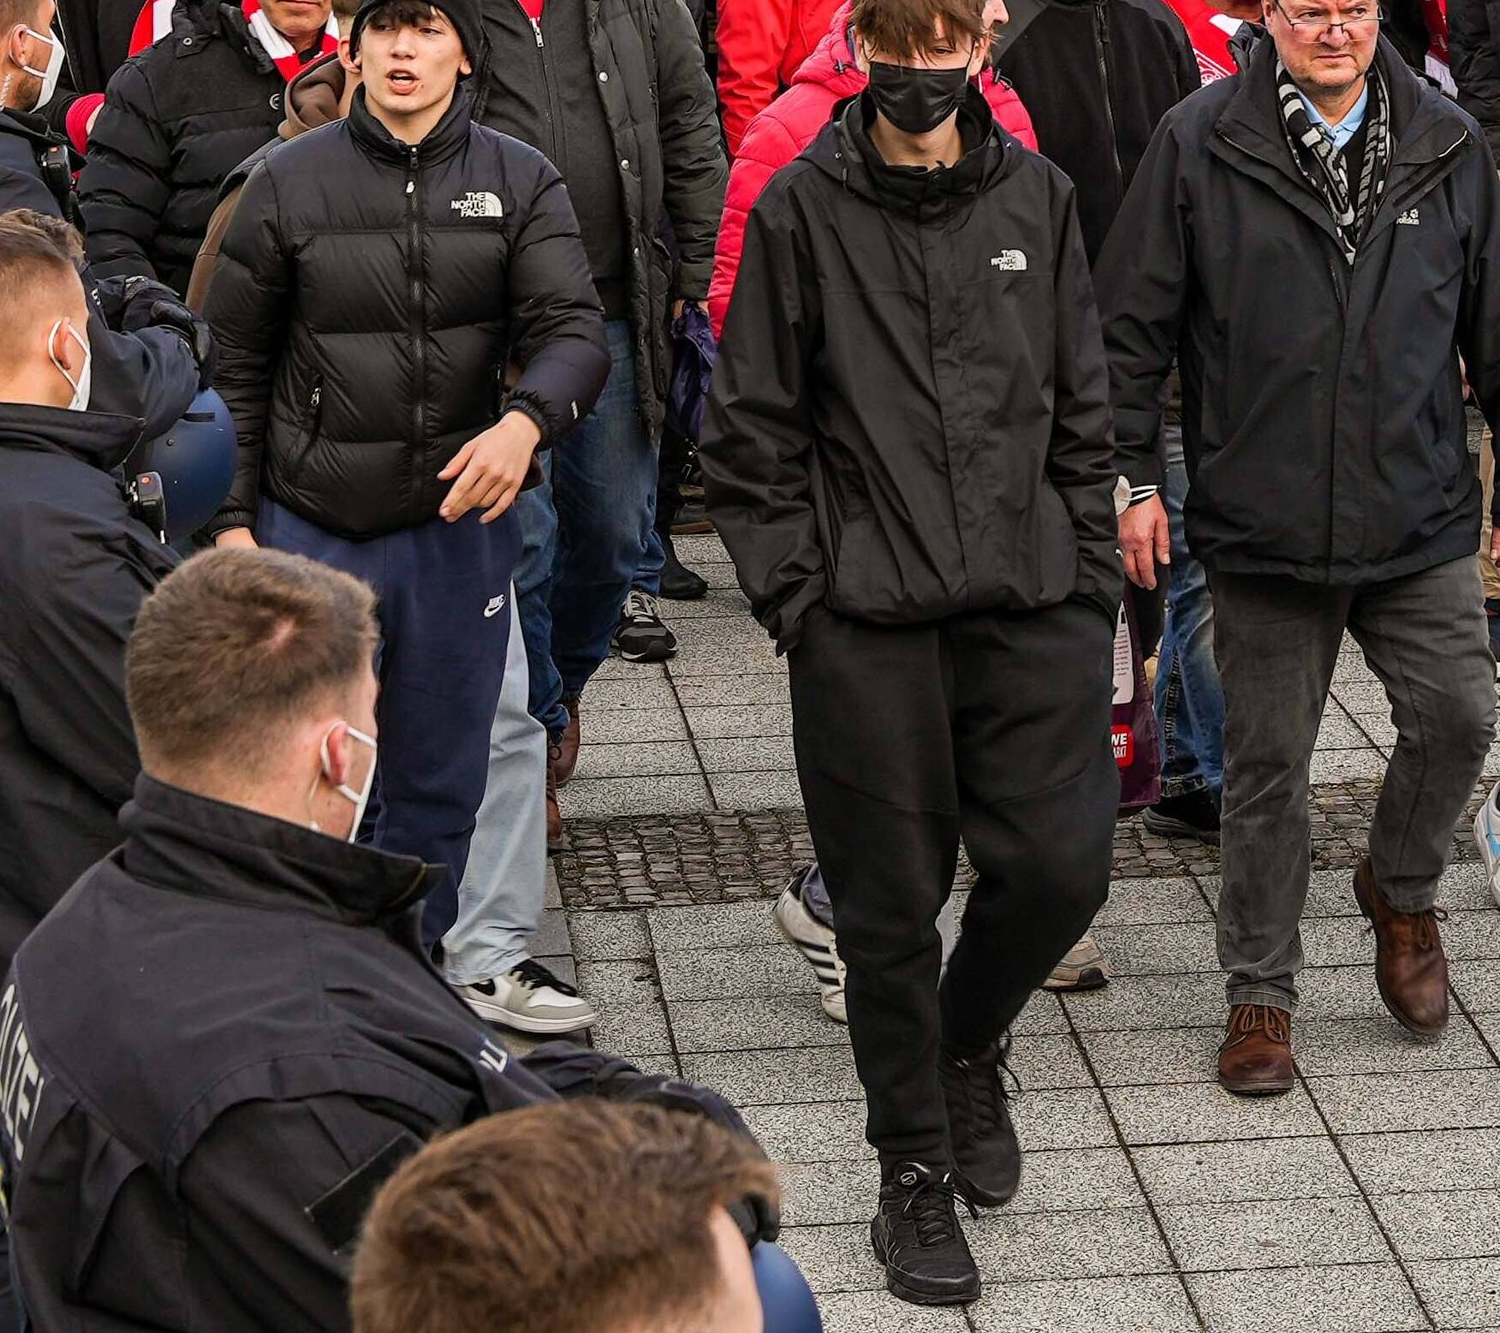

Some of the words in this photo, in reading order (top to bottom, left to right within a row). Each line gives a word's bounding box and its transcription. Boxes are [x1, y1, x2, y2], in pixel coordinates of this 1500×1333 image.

[466, 192, 485, 200] THE
[451, 200, 485, 209] NORTH
[461, 208, 485, 217] FACE
